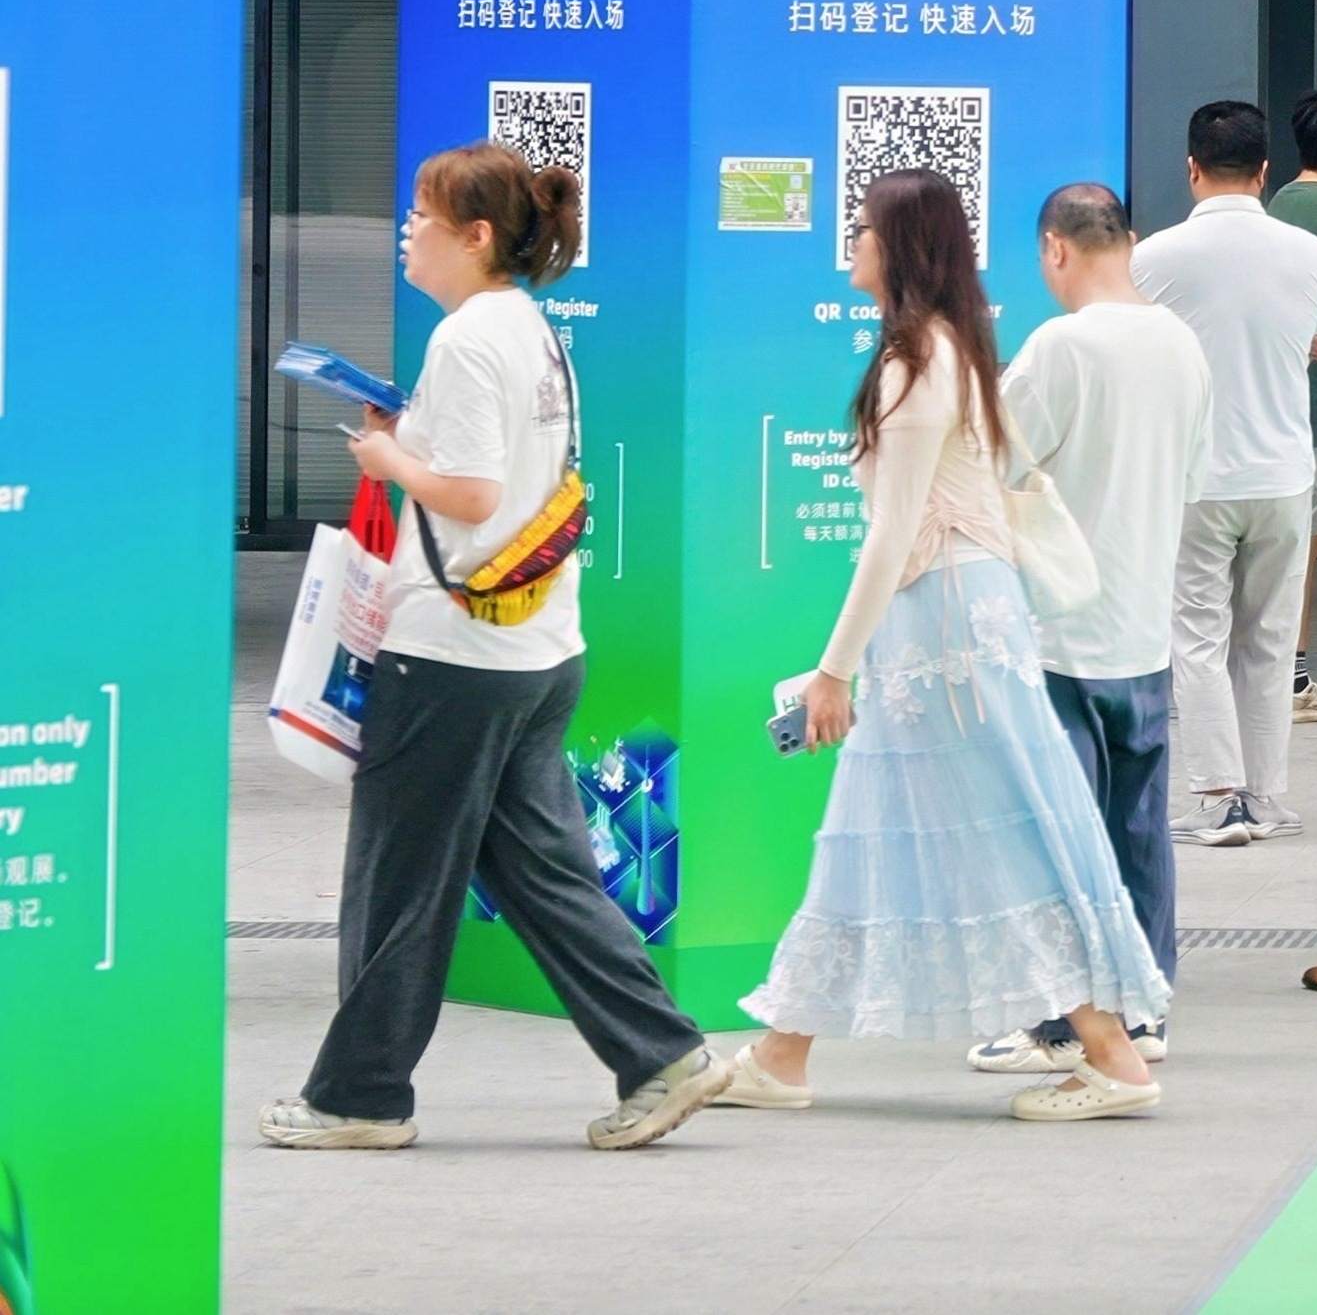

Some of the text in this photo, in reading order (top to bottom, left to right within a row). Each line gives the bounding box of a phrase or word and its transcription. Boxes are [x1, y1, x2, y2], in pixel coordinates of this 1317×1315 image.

[789, 0, 1036, 36] 扫码登记 快速入场
[546, 298, 599, 320] Register
[814, 303, 841, 322] QR
[784, 429, 848, 448] Entry by
[791, 450, 850, 470] Registe
[822, 473, 839, 488] ID
[796, 502, 863, 519] 必须提前
[32, 714, 91, 748] only
[0, 755, 77, 788] umber
